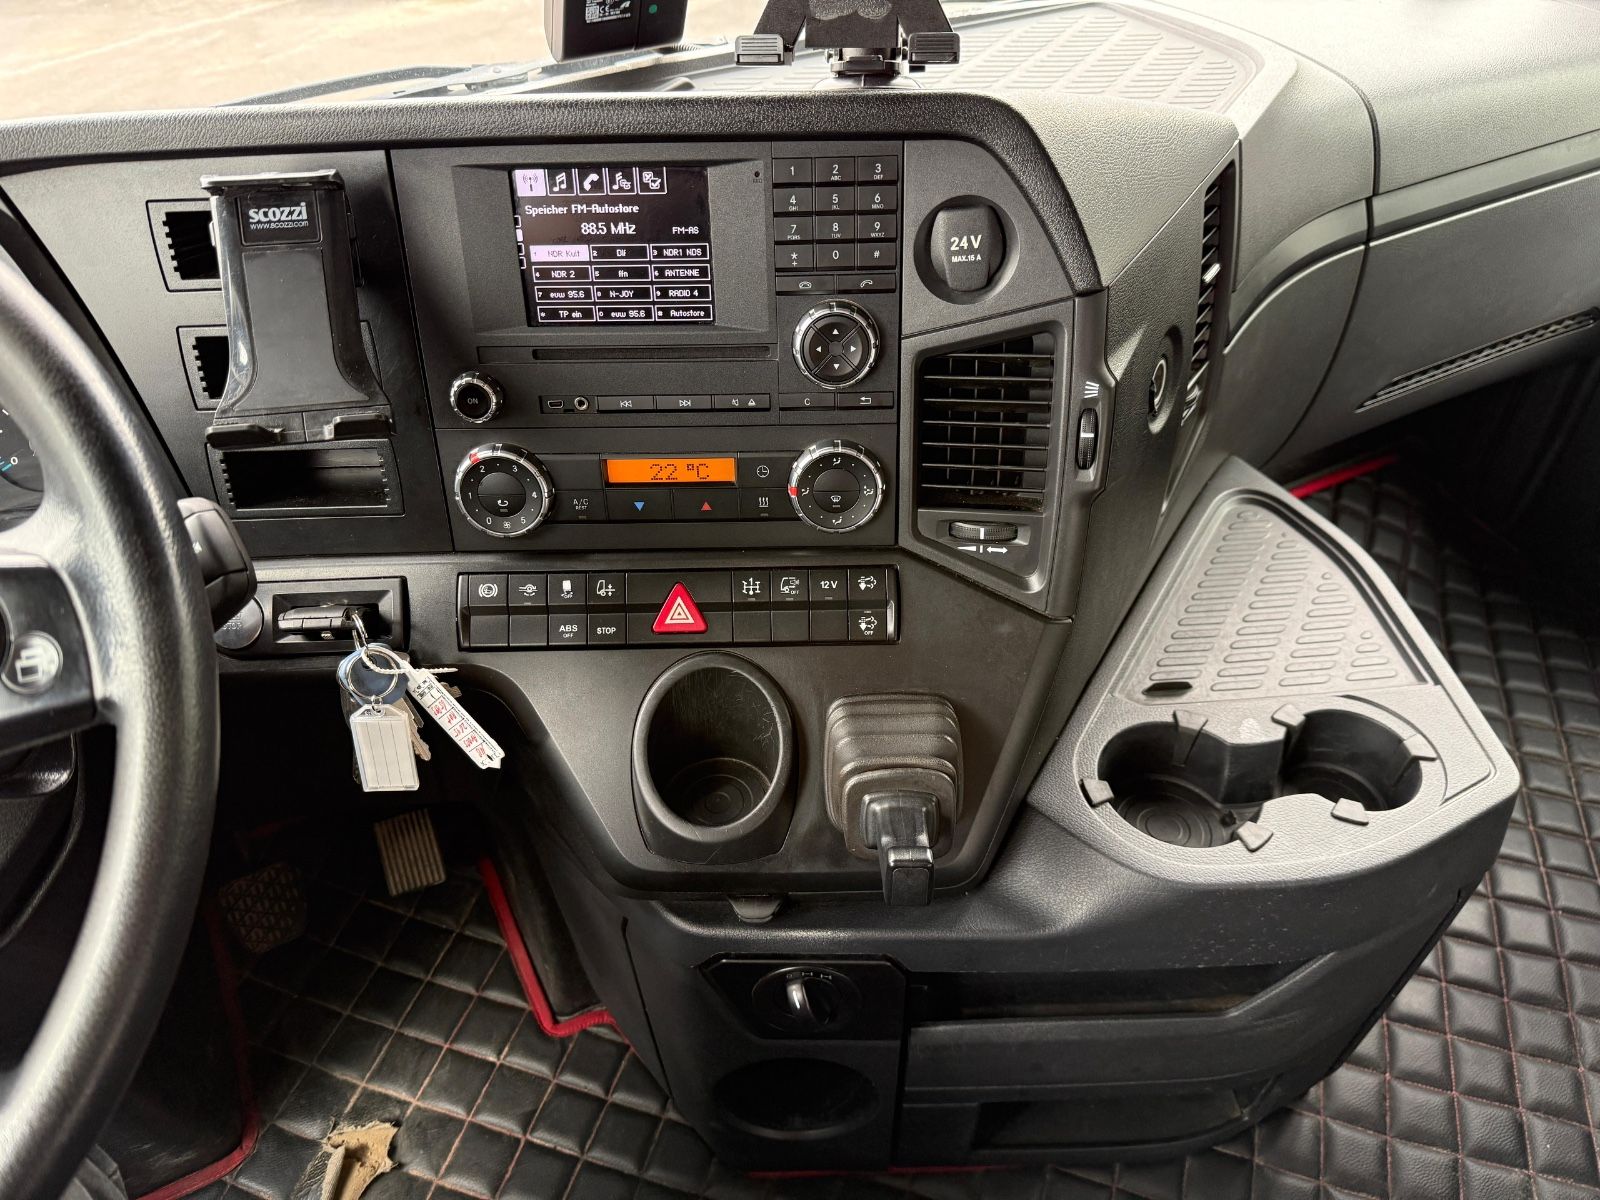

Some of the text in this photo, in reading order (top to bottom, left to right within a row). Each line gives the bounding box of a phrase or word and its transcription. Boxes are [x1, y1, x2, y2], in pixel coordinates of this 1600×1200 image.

[790, 166, 795, 176] 1
[832, 164, 839, 174] 2
[875, 163, 882, 173] 3
[789, 194, 797, 205] 4
[832, 193, 839, 203] 5
[874, 193, 881, 203] 6
[524, 203, 640, 215] Speicher FM-Autostore
[249, 220, 309, 230] www.scozzi.com
[580, 222, 636, 234] 88.5 MHz
[790, 224, 797, 234] 7
[832, 222, 839, 232] 8
[874, 221, 880, 231] 9
[672, 226, 699, 234] FM-AS
[547, 250, 563, 258] NDR
[663, 248, 683, 256] NDR1
[686, 248, 702, 256] NDS
[551, 270, 567, 278] NDR
[665, 269, 700, 277] ANTENNE
[609, 290, 634, 298] N-JOY
[668, 289, 691, 297] RADIO
[692, 289, 699, 297] 4
[558, 310, 582, 318] TP ein
[628, 310, 646, 318] 95.6
[670, 309, 705, 317] Autostore
[467, 397, 479, 405] ON
[804, 398, 811, 406] C
[479, 465, 486, 473] 2
[512, 465, 518, 473] 3
[650, 463, 678, 481] 22
[573, 498, 589, 506] A/C
[596, 627, 616, 635] STOP
